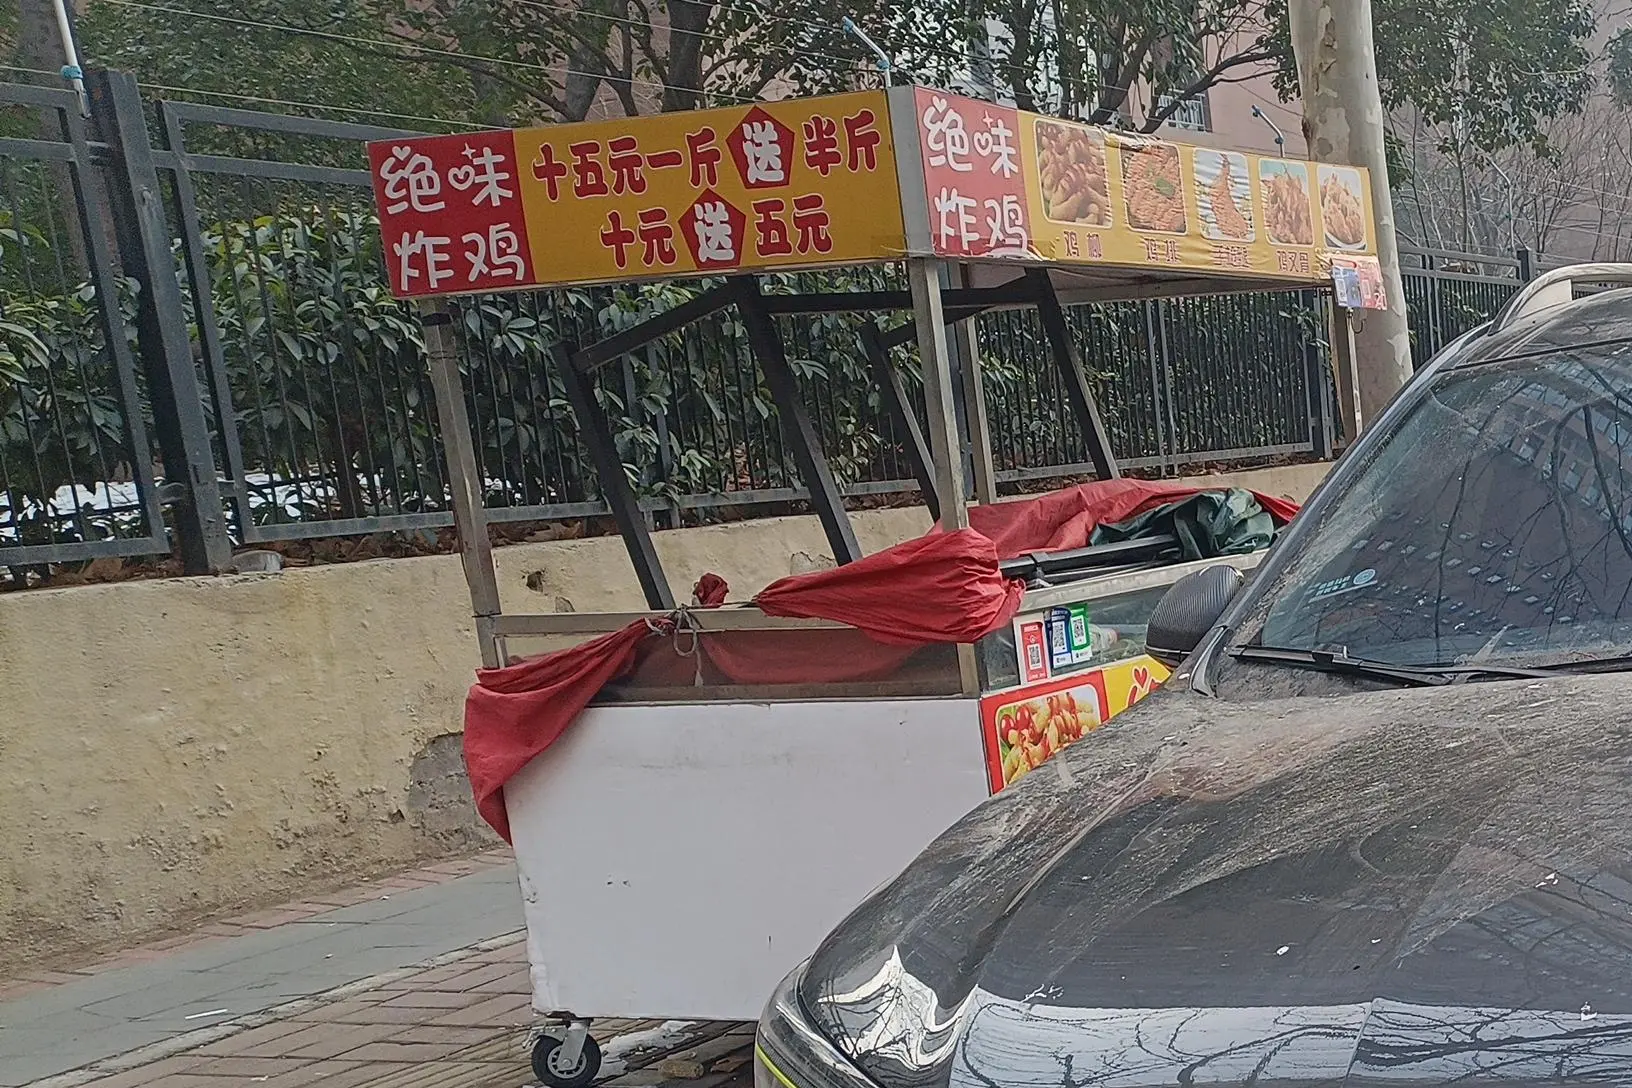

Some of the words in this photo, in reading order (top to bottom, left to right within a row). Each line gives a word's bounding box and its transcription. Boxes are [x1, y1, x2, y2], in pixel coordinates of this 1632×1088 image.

[532, 107, 883, 203] 十五元一斤送半斤
[922, 95, 1019, 179] 绝味
[379, 143, 513, 215] 绝味
[600, 193, 835, 270] 十元送五元
[934, 187, 1028, 250] 炸鸡
[393, 223, 525, 291] 炸鸡
